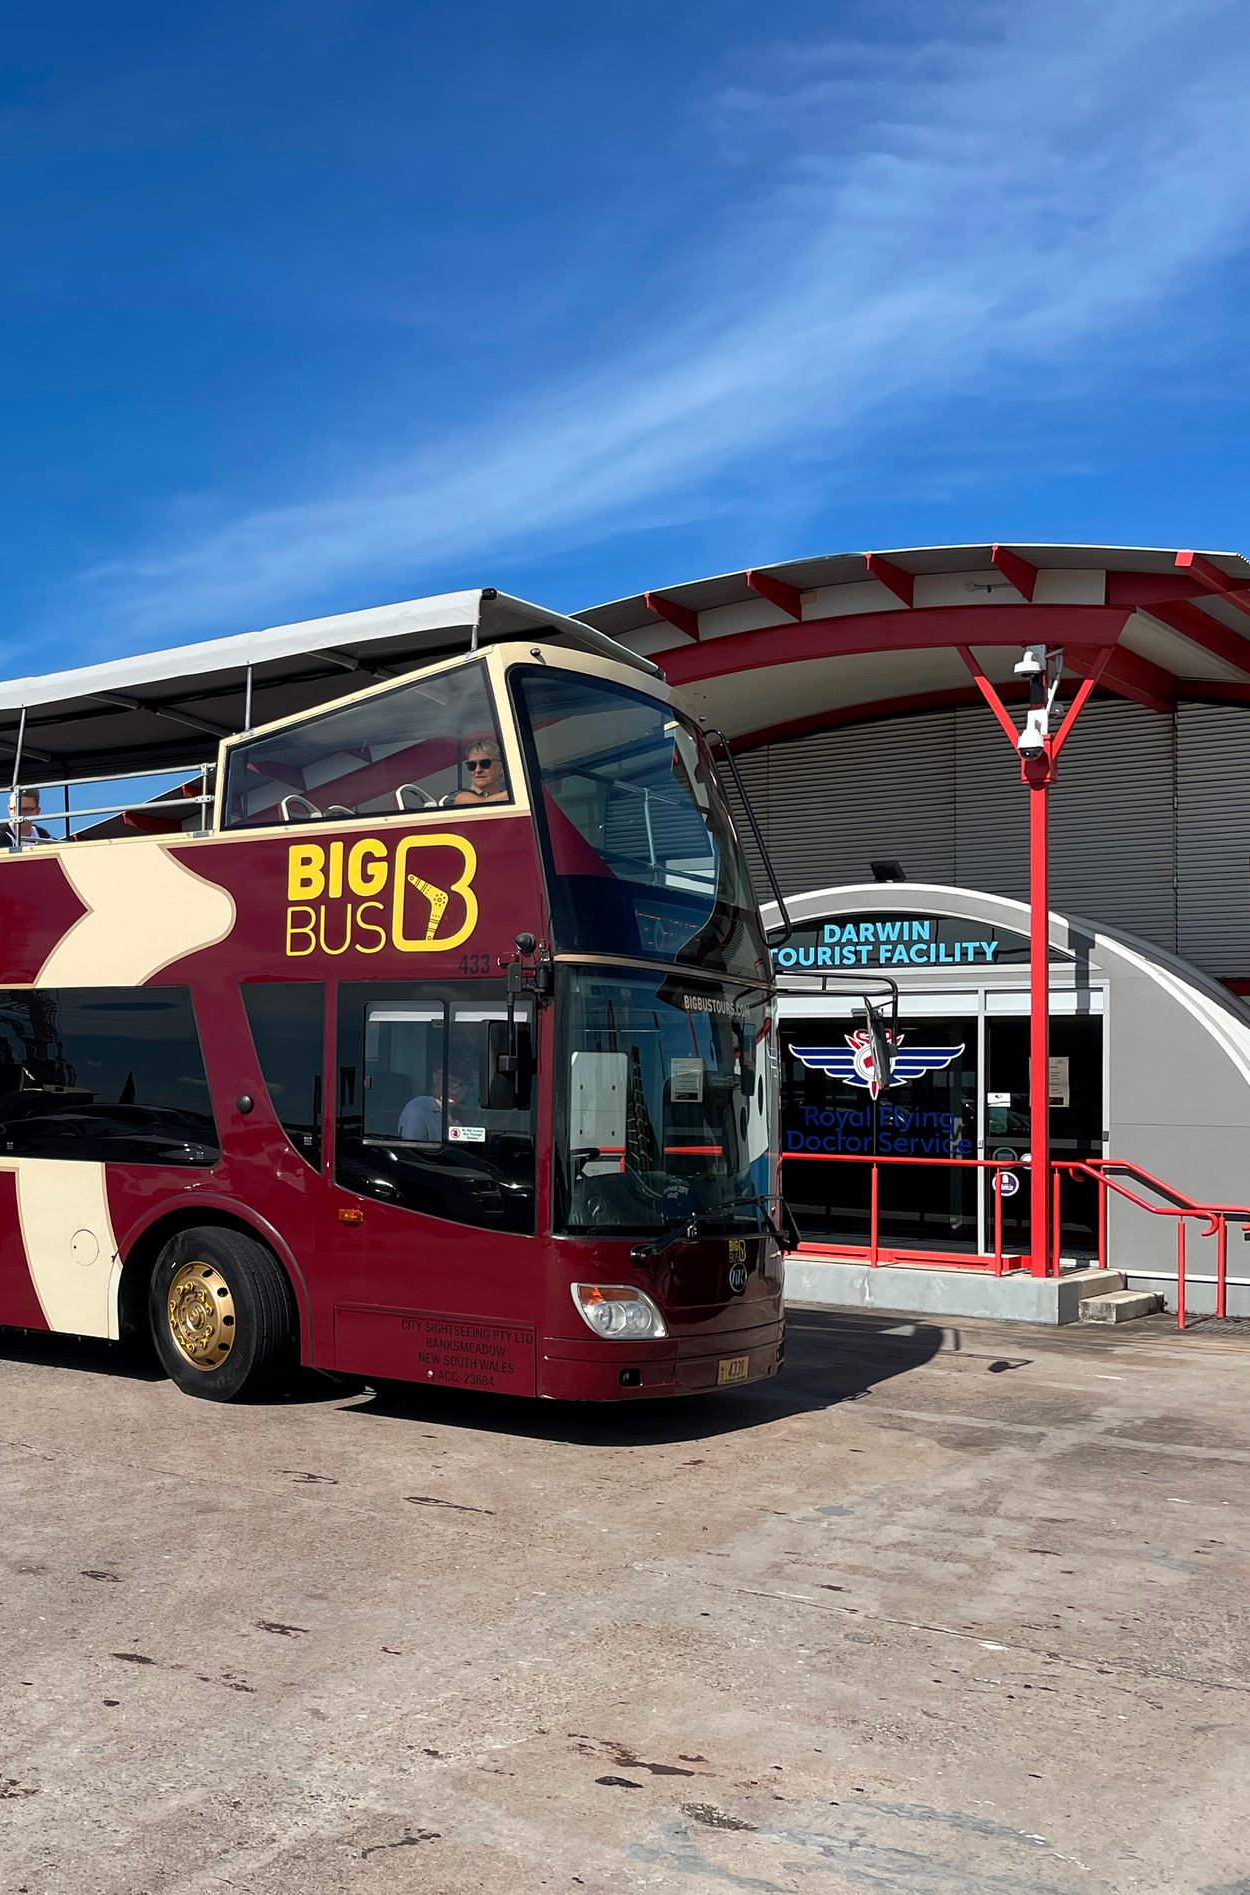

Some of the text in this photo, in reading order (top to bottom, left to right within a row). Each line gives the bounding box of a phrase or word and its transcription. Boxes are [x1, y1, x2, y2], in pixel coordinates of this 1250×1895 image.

[288, 838, 389, 901] BIG
[286, 901, 387, 957] BUS
[823, 920, 930, 944] DARWIN
[458, 954, 491, 974] 433
[769, 941, 999, 967] TOURIST FACILITY
[804, 1105, 956, 1133] Royal Flying
[786, 1130, 973, 1155] Doctor Service
[401, 1319, 534, 1345] CITY SIGHTSEEING PTY LTD
[426, 1337, 506, 1357] BANKSMEADOW
[418, 1352, 515, 1374] NEW SOUTH WALES
[438, 1370, 461, 1383] ACC.
